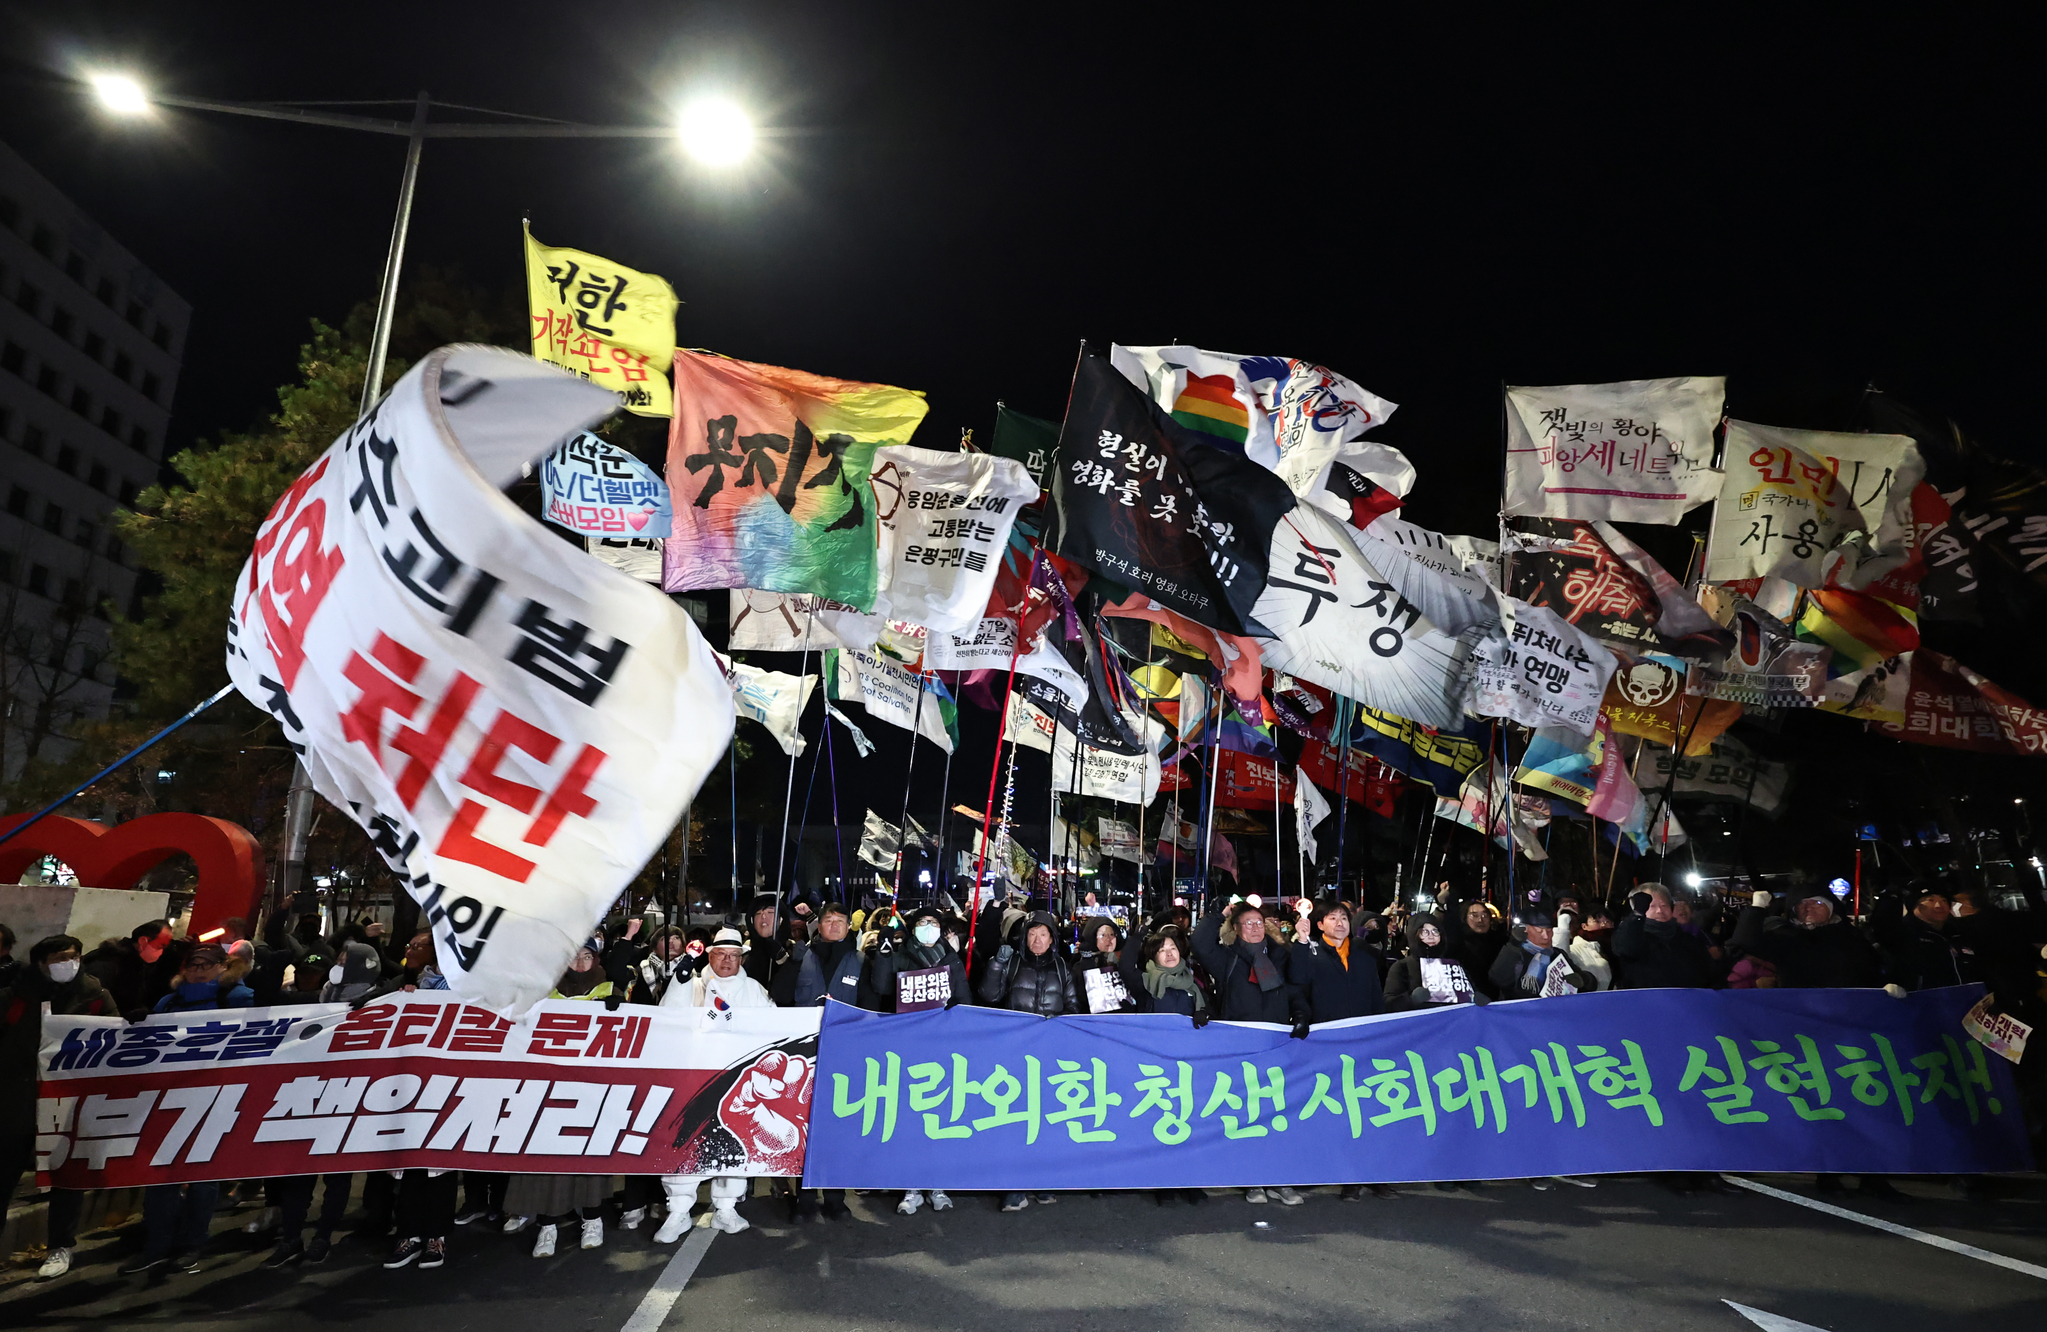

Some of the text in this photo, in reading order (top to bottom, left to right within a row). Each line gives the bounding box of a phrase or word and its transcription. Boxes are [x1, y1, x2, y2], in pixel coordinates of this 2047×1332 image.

[1539, 407, 1662, 445] 잿빛의 황야
[1098, 430, 1167, 481] 현실이
[1071, 460, 1141, 507] 영화를
[927, 518, 996, 543] 고통받는
[904, 545, 988, 573] 은평구민들
[1094, 548, 1209, 610] 방구석 호러 영화 오타쿠
[1268, 540, 1422, 658] 투쟁
[1523, 655, 1571, 694] 연맹
[338, 630, 609, 884] 처단
[900, 970, 950, 991] 내란외환
[900, 985, 952, 1004] 청산하자
[327, 1003, 517, 1054] 옵티칼
[526, 1012, 652, 1059] 문제
[832, 1032, 2002, 1146] 내란외환 청산! 사회대개혁 실현하자!
[253, 1073, 675, 1156] 책임져라!
